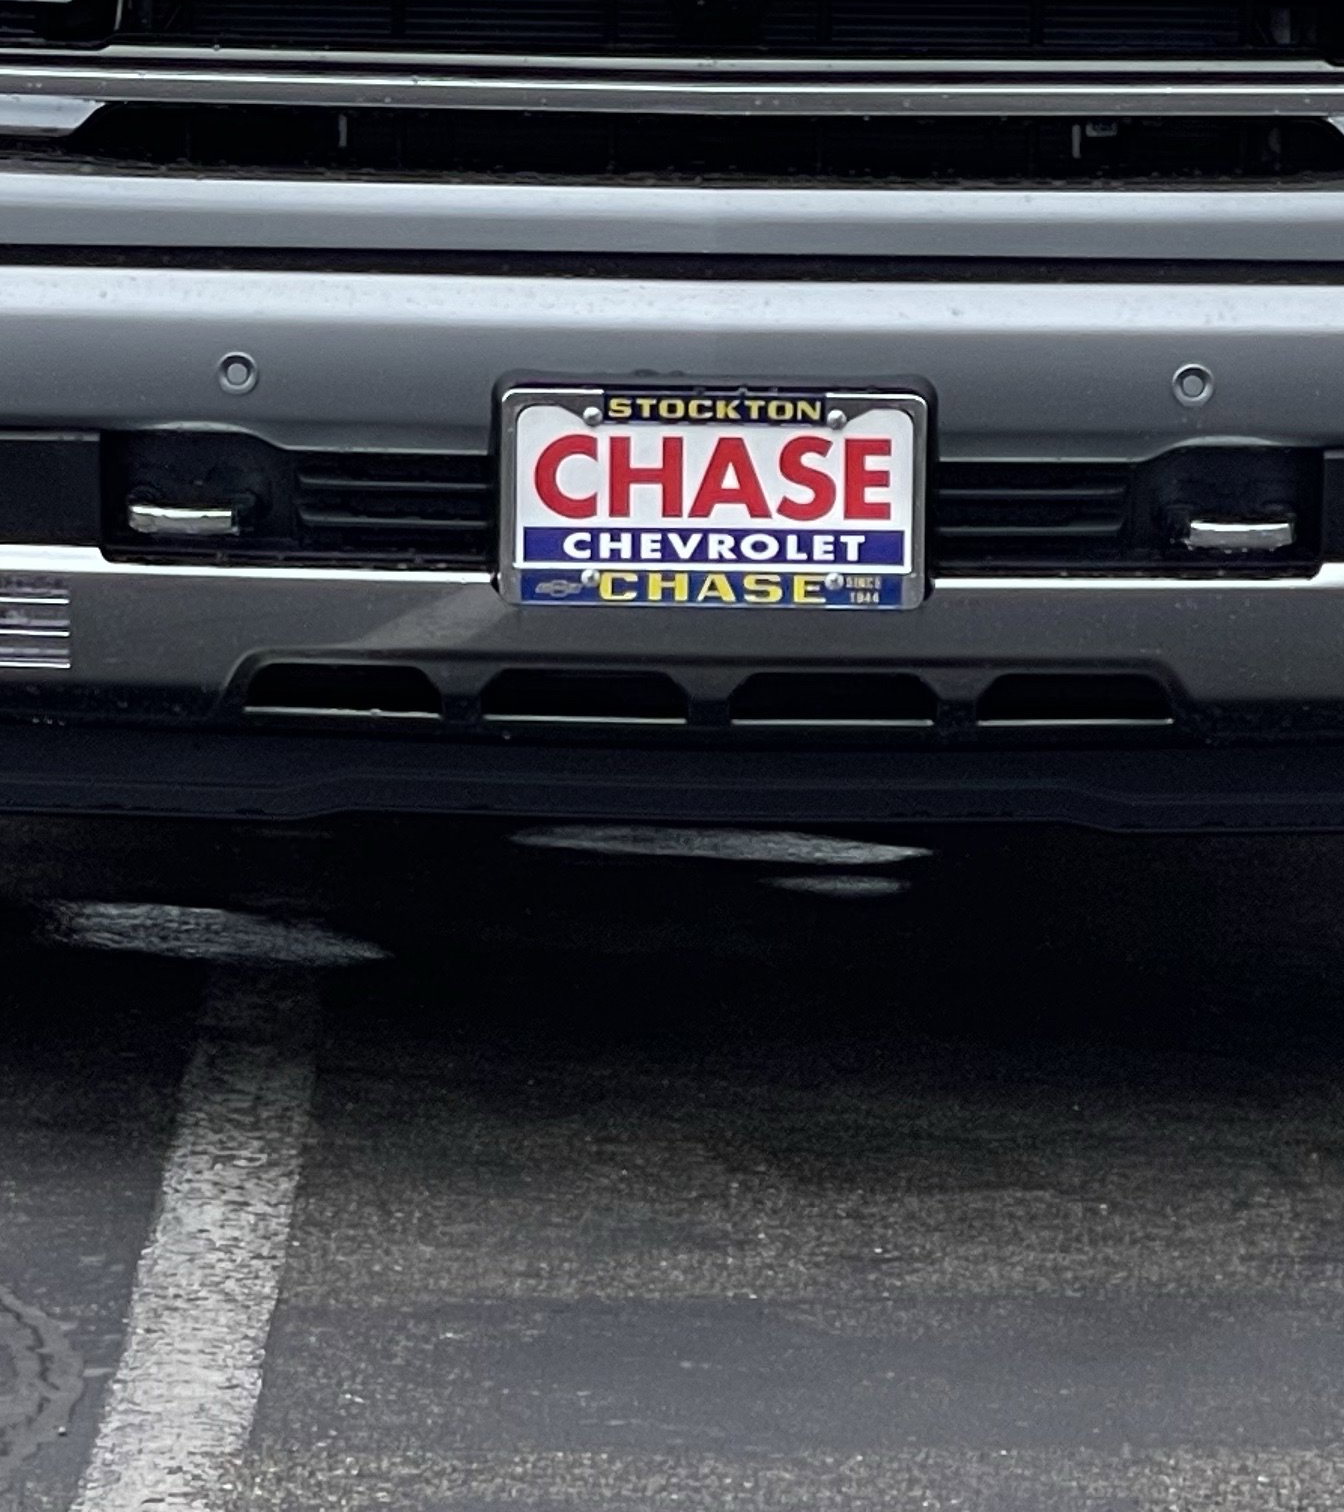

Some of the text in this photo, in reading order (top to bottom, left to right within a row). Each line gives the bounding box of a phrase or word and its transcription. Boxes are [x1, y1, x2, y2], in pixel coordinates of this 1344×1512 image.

[607, 397, 822, 421] STOCKTON
[533, 433, 892, 521] CHASE
[562, 532, 866, 562] CHEVROLET
[598, 571, 828, 603] CHASE
